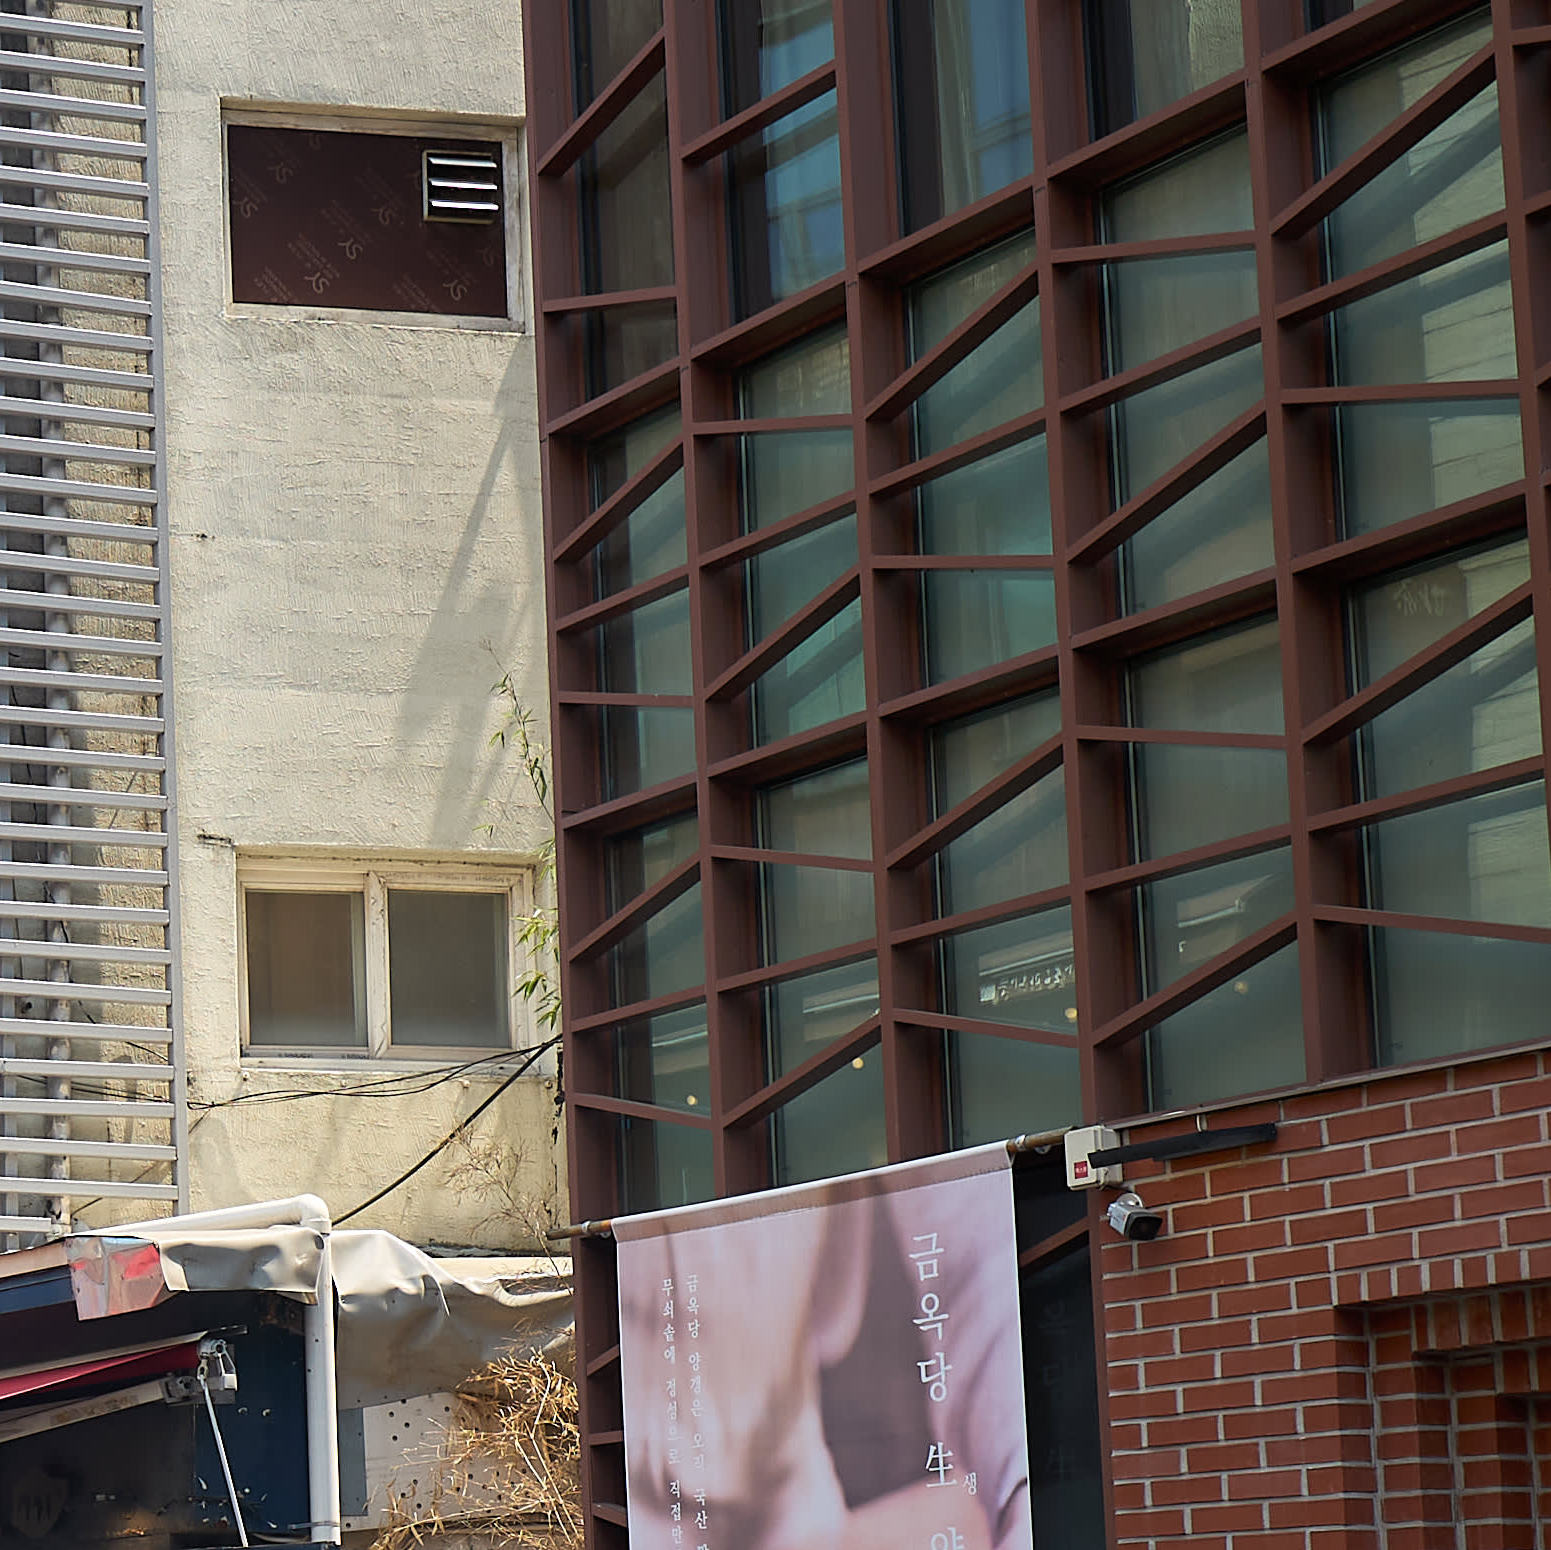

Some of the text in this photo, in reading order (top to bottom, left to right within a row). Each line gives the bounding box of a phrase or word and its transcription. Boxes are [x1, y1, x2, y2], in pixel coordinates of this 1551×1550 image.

[909, 1231, 953, 1402] 금옥당
[685, 1274, 700, 1339] 금옥당
[694, 1488, 708, 1530] 국산
[925, 1441, 958, 1490] 生
[962, 1472, 978, 1496] 생
